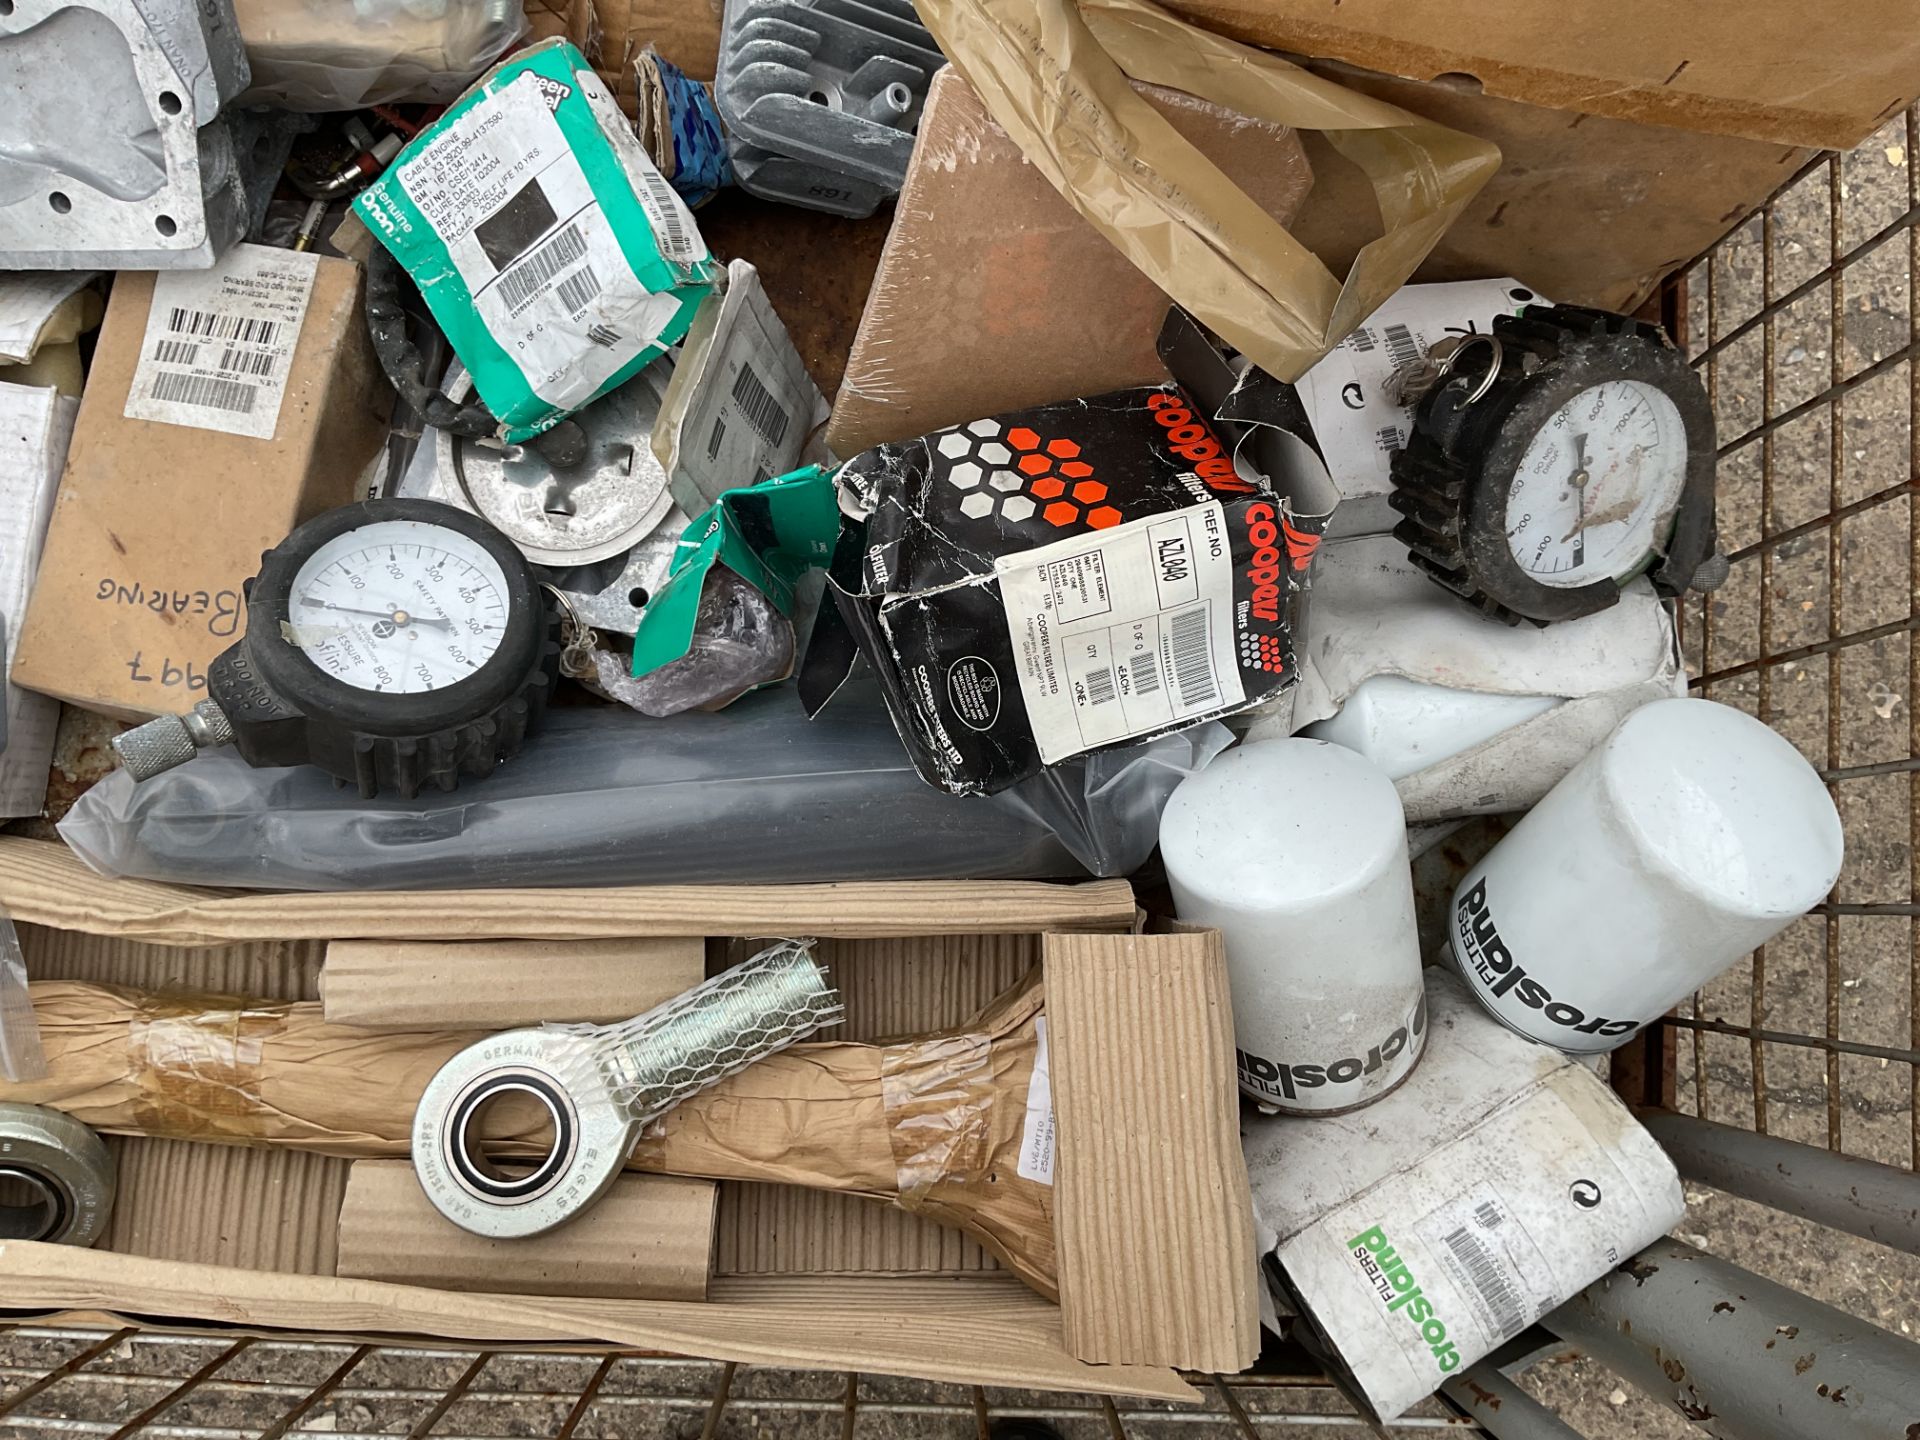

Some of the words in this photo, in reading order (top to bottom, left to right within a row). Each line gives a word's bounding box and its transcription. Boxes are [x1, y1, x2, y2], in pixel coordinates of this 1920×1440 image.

[162, 38, 191, 78] ONAN
[431, 160, 445, 174] X3
[441, 110, 504, 165] 2920-99-4137590
[402, 156, 431, 183] CABLE
[428, 131, 460, 161] ENGINE
[447, 152, 488, 189] CSE/12414
[429, 195, 455, 219] CURE
[451, 179, 474, 200] DATE
[472, 156, 501, 182] 1Q2004
[470, 184, 498, 209] SHELF
[496, 170, 515, 187] LIFE
[512, 160, 524, 172] 10
[372, 180, 415, 234] Genuine
[444, 214, 475, 243] PACKED
[478, 187, 509, 215] 2Q2004
[683, 235, 692, 253] LEAD
[571, 307, 589, 323] EACH
[517, 340, 526, 349] D
[525, 329, 536, 341] OF
[1552, 407, 1571, 429] 500
[1586, 398, 1606, 421] 600
[1613, 410, 1632, 433] 700
[1532, 461, 1544, 475] DO
[1541, 442, 1557, 461] NOT
[1540, 449, 1561, 475] DROP
[1174, 470, 1212, 501] filters
[1507, 478, 1525, 500] 300
[1513, 512, 1532, 534] 200
[1536, 534, 1552, 553] 100
[1571, 538, 1582, 548] 0
[385, 560, 404, 581] 200
[1066, 560, 1074, 573] QTY
[1091, 553, 1100, 573] FILTER
[1157, 537, 1188, 581] AZL040
[348, 572, 365, 590] 100
[424, 563, 443, 583] 300
[1037, 564, 1047, 582] EACH
[1057, 563, 1068, 586] AZL040
[1069, 576, 1077, 589] ONE
[414, 578, 436, 605] SAFETY
[456, 584, 475, 605] 400
[1095, 576, 1105, 601] ELEMENT
[93, 577, 241, 637] BEARING
[1237, 600, 1249, 628] filters
[464, 615, 483, 637] 500
[1036, 612, 1049, 645] COOPERS
[1133, 631, 1143, 641] OF
[446, 642, 466, 663] 600
[1042, 644, 1053, 667] FILTERS
[1086, 644, 1097, 659] QTY
[372, 663, 392, 685] 800
[413, 661, 433, 683] 700
[1045, 668, 1059, 694] LIMITED
[232, 660, 251, 679] DO
[246, 685, 282, 714] NOT
[957, 674, 973, 708] RECYCLABLE
[969, 708, 977, 720] AND
[961, 665, 973, 690] RECYCLED
[969, 690, 980, 708] BOARD
[976, 708, 984, 720] AND
[970, 672, 978, 683] BOX
[975, 688, 985, 704] MADE
[980, 703, 990, 717] WITH
[916, 664, 938, 712] COOPERS
[946, 746, 963, 765] LTD
[1457, 906, 1496, 986] FILTERS
[1459, 875, 1640, 1038] crosland
[556, 1147, 597, 1208] ELGES
[1471, 1213, 1485, 1229] QTY
[1352, 1245, 1395, 1302] FILTERS
[1442, 1253, 1470, 1288] FILTER
[1346, 1222, 1462, 1374] crosland
